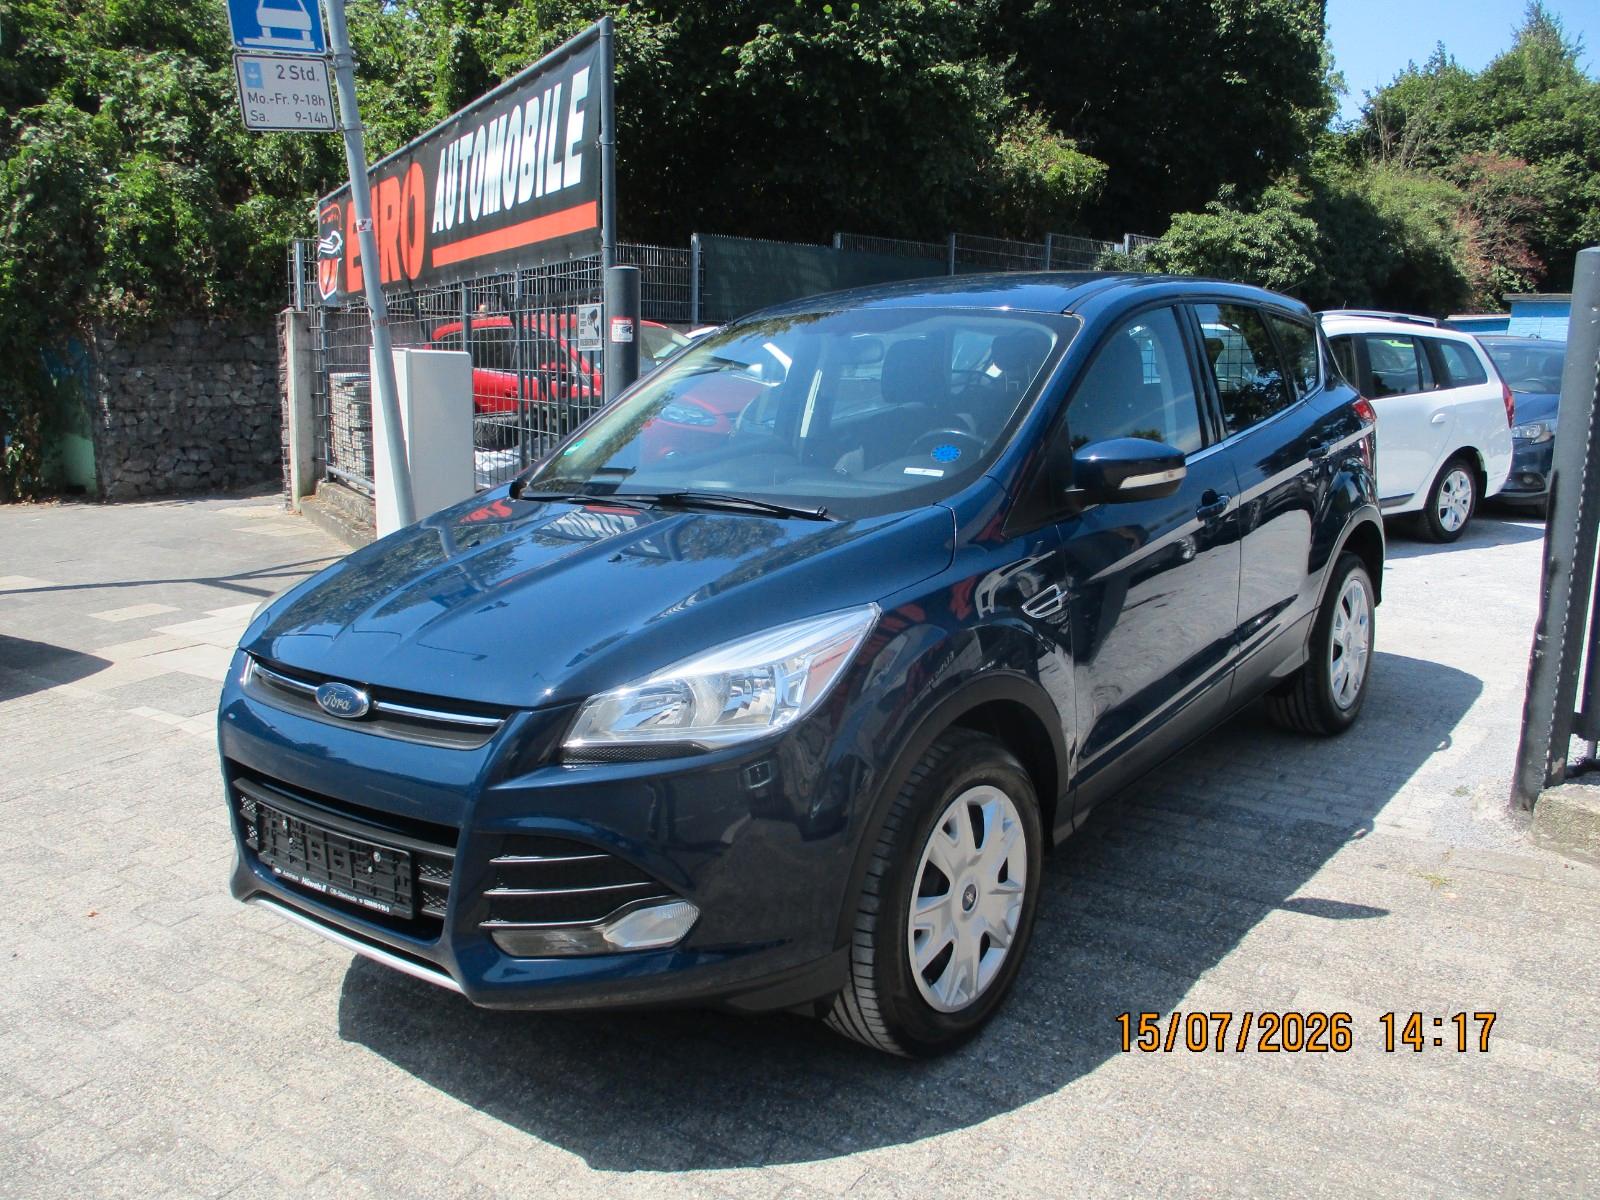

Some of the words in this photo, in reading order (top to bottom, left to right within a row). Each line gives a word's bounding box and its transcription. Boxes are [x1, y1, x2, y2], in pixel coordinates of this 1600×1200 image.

[275, 64, 286, 80] 2
[289, 65, 320, 82] Std.
[292, 93, 326, 107] 9-18h
[250, 109, 270, 122] Sa.
[295, 111, 328, 124] 9-14h
[431, 66, 590, 234] AUTOMOBILE
[323, 687, 352, 711] Ford
